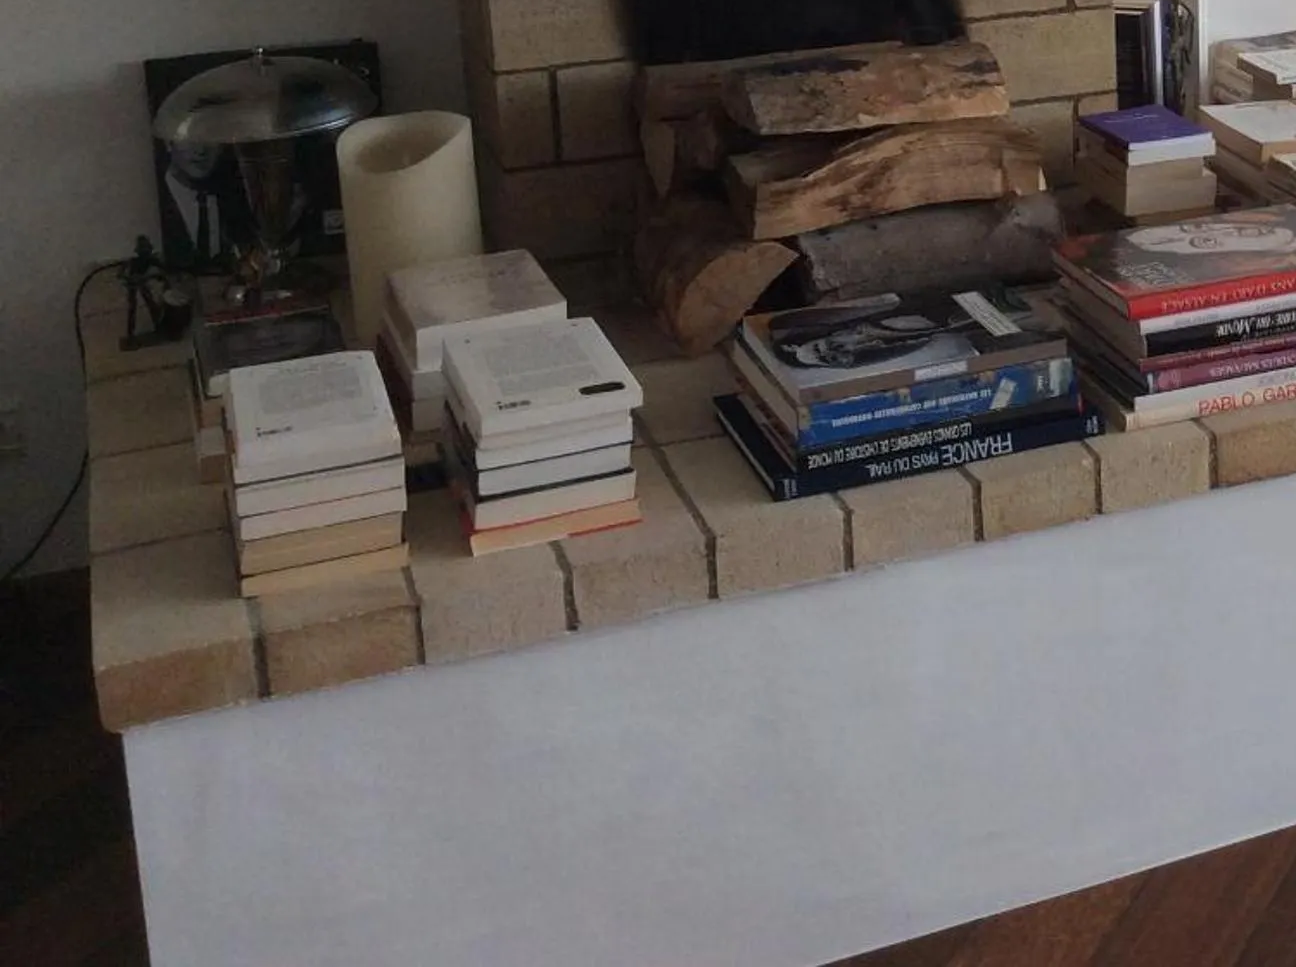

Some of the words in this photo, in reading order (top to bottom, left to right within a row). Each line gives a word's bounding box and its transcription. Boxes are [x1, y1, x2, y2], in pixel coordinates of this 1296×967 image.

[1198, 391, 1255, 416] PABLO
[941, 432, 1013, 466] FRANCE
[808, 451, 833, 470] MONDE
[893, 456, 910, 473] DU
[912, 450, 939, 469] PAYS
[865, 462, 893, 478] RAIL
